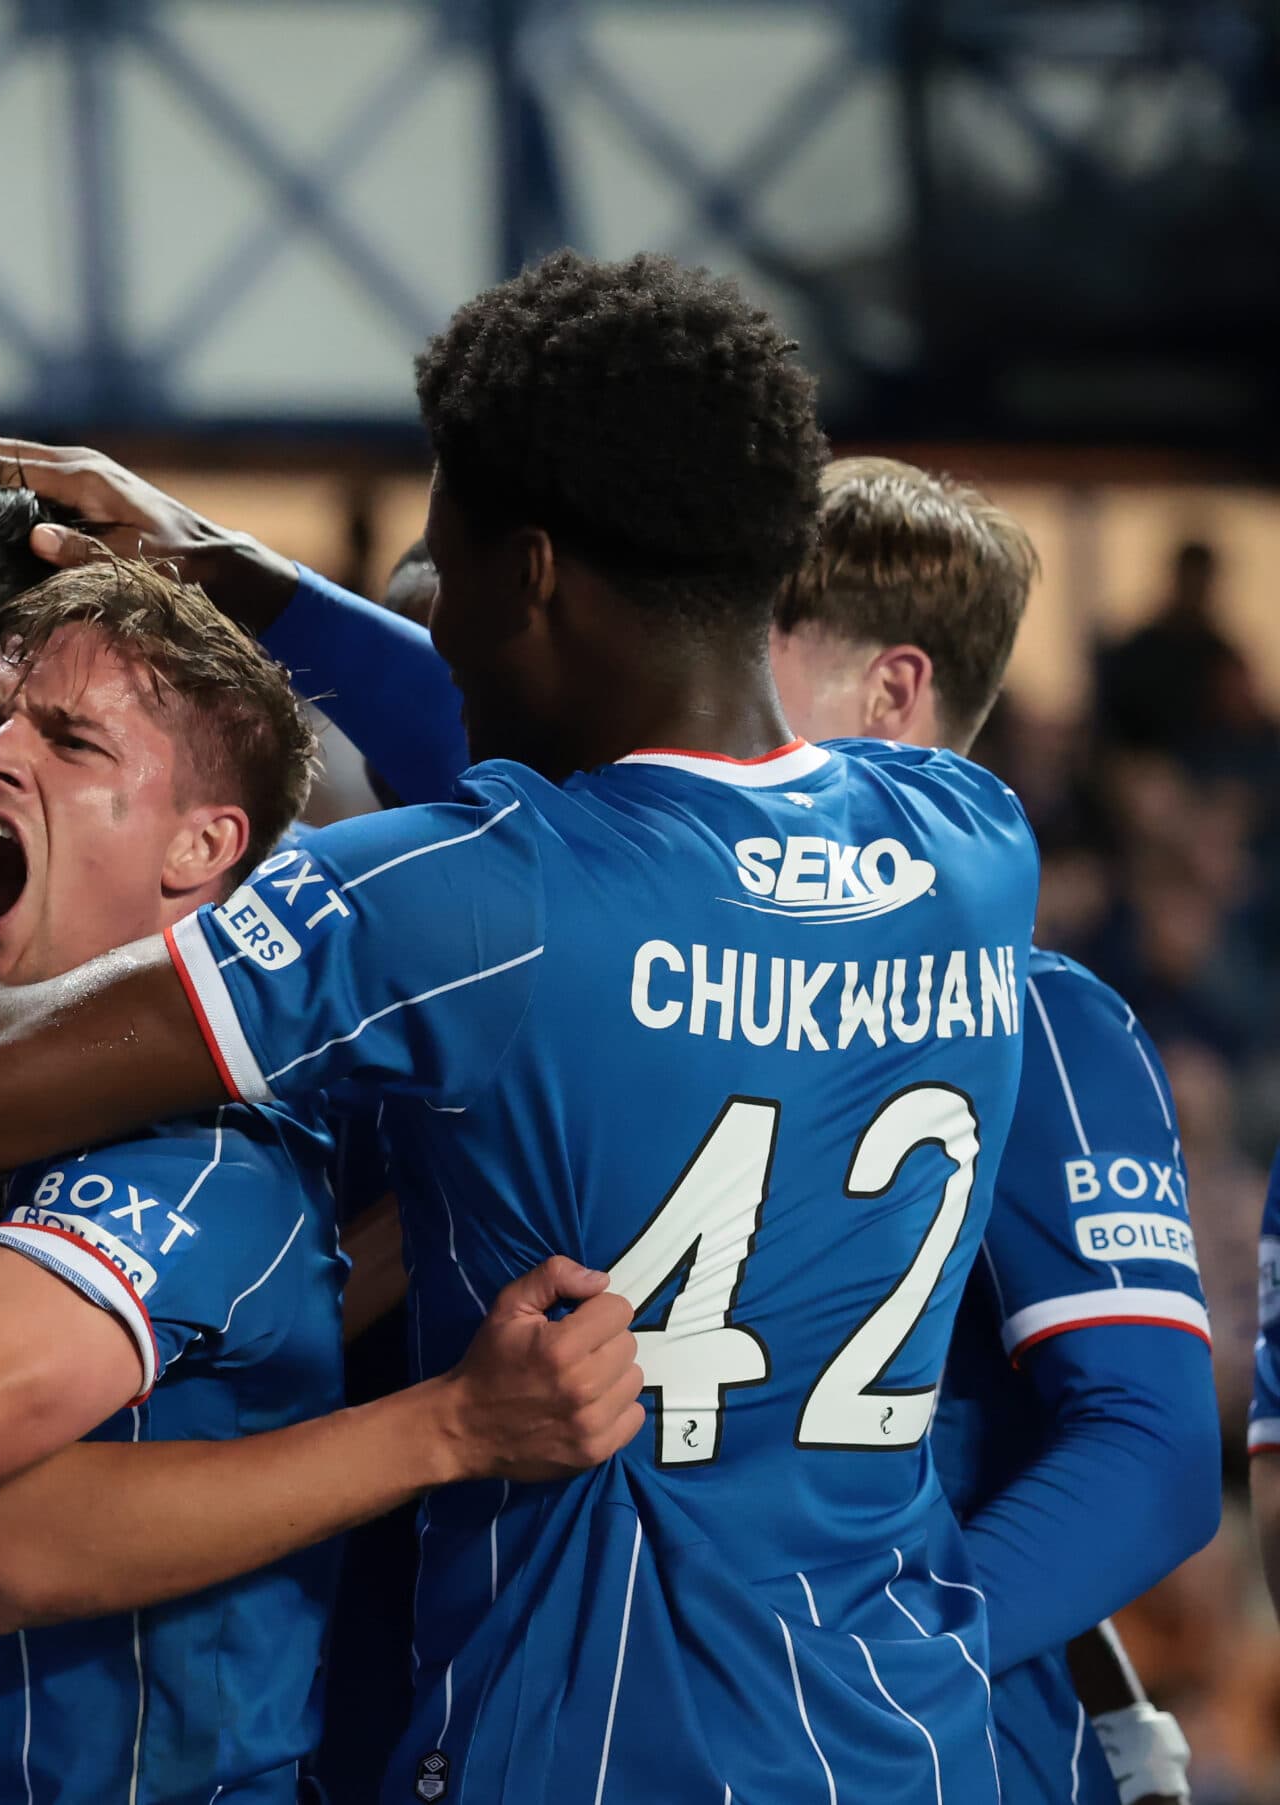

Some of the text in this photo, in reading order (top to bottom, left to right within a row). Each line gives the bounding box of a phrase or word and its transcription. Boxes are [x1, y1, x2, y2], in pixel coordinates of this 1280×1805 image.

[257, 849, 351, 930] OXT
[734, 836, 936, 902] SEKO
[220, 904, 285, 962] ERS
[630, 939, 1019, 1052] CHUKWUANI
[33, 1171, 196, 1256] BOXT
[603, 1080, 980, 1470] 42
